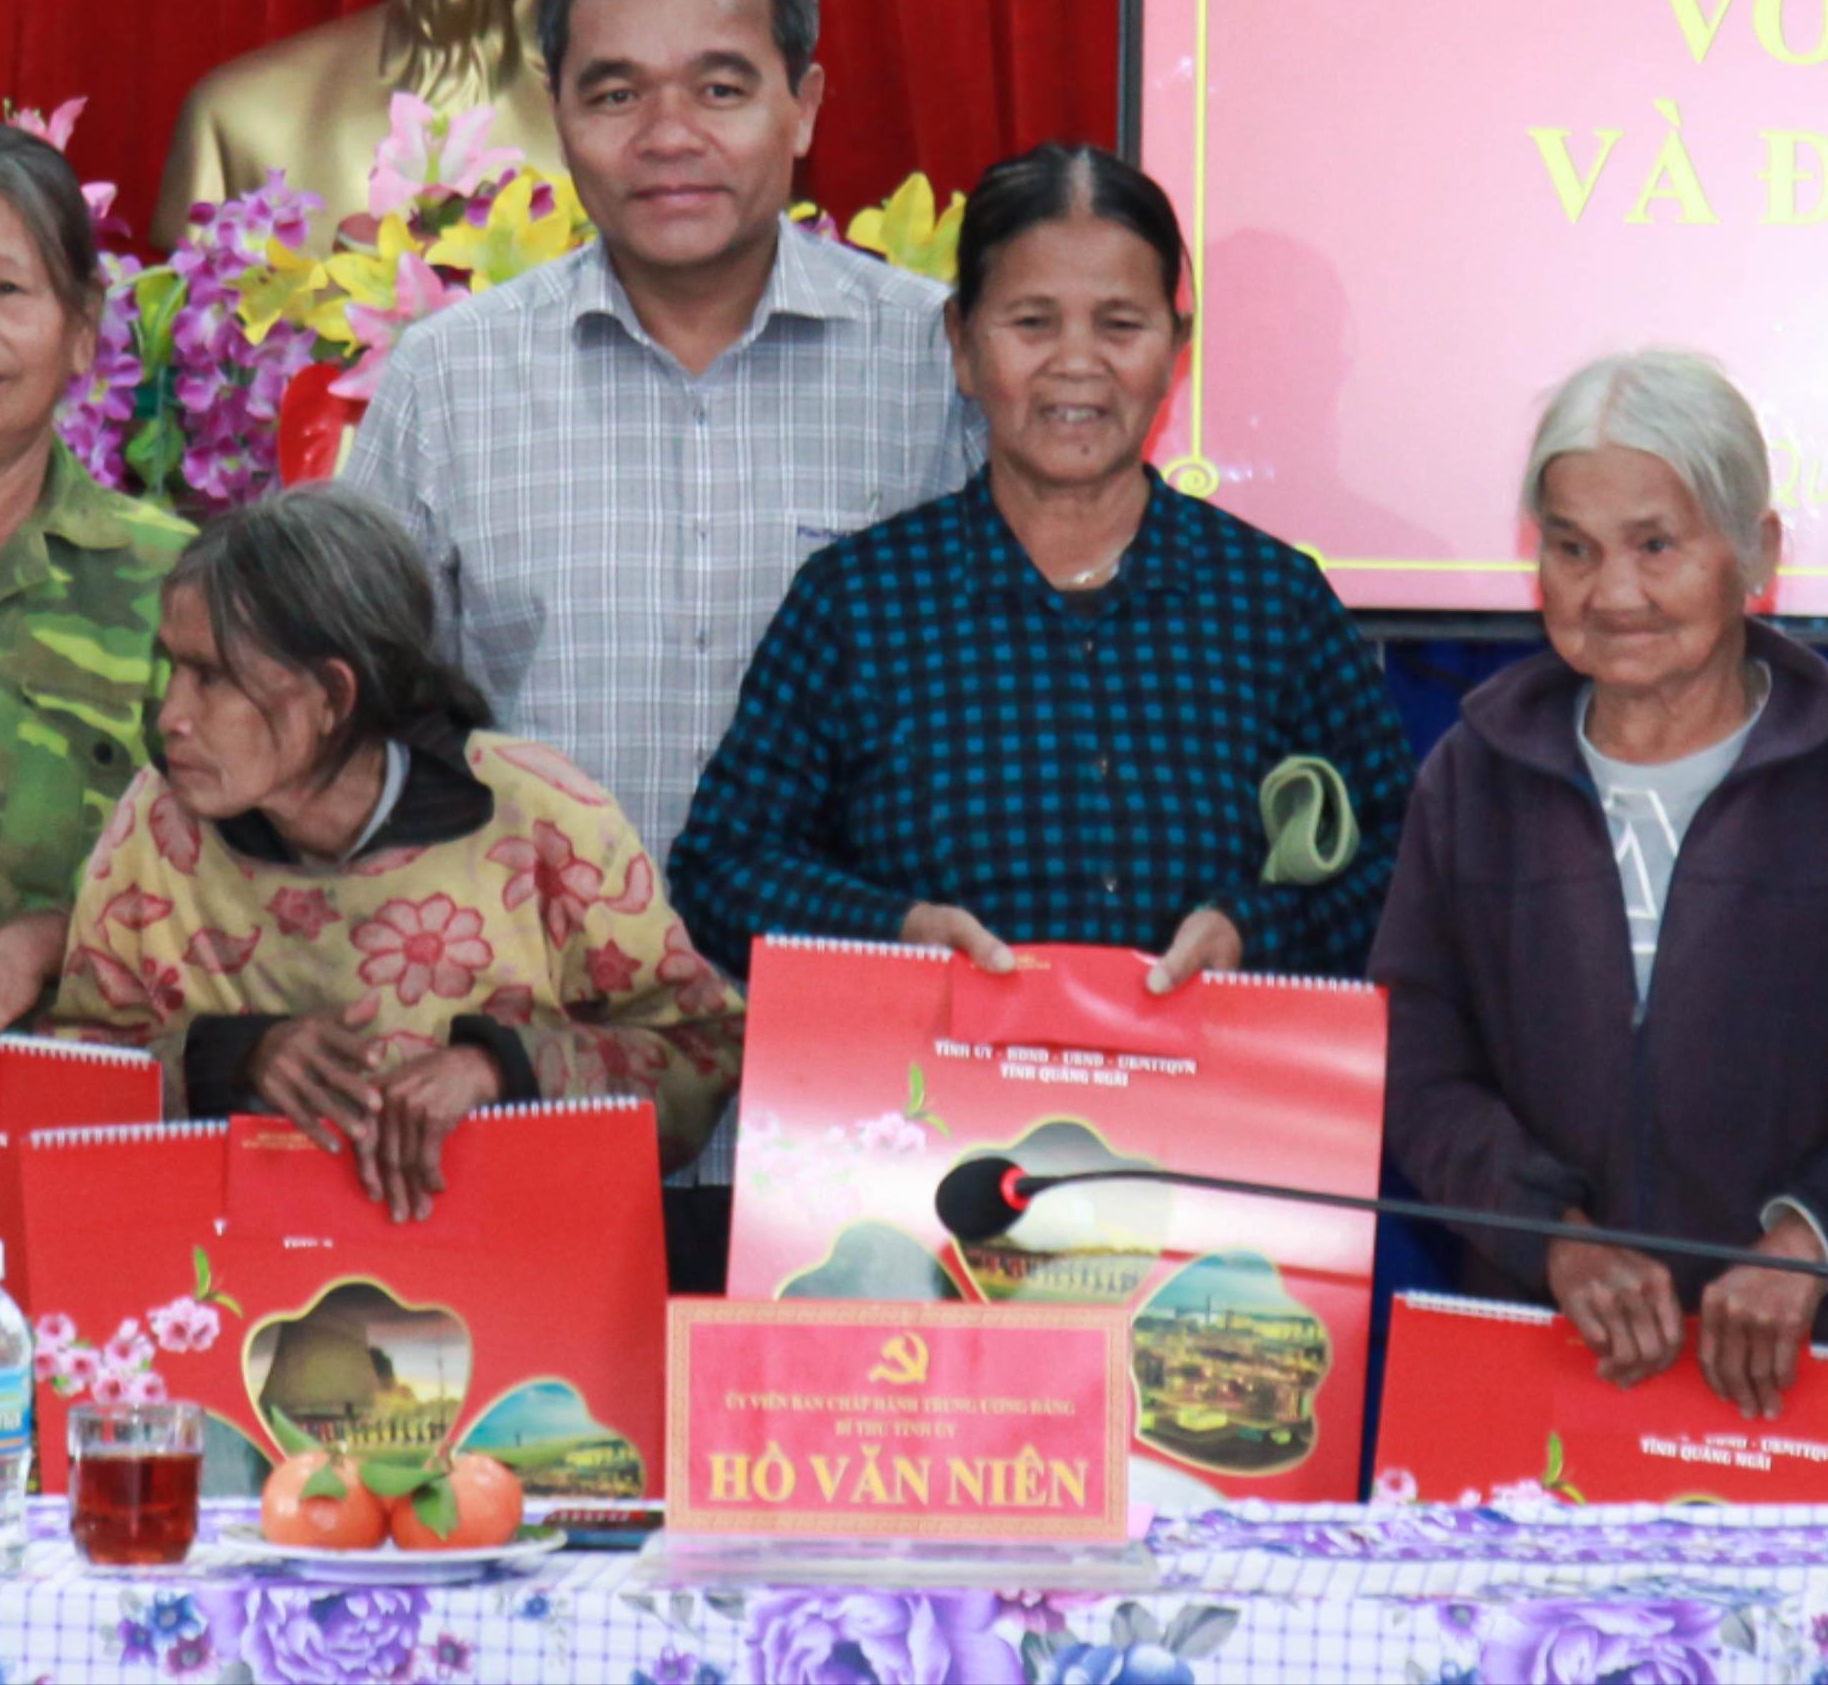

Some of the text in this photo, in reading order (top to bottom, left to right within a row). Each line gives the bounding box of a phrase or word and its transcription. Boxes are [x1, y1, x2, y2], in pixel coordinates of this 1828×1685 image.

[1527, 97, 1720, 227] VÀ
[708, 1438, 1090, 1508] HỒ VĂN NIÊN
